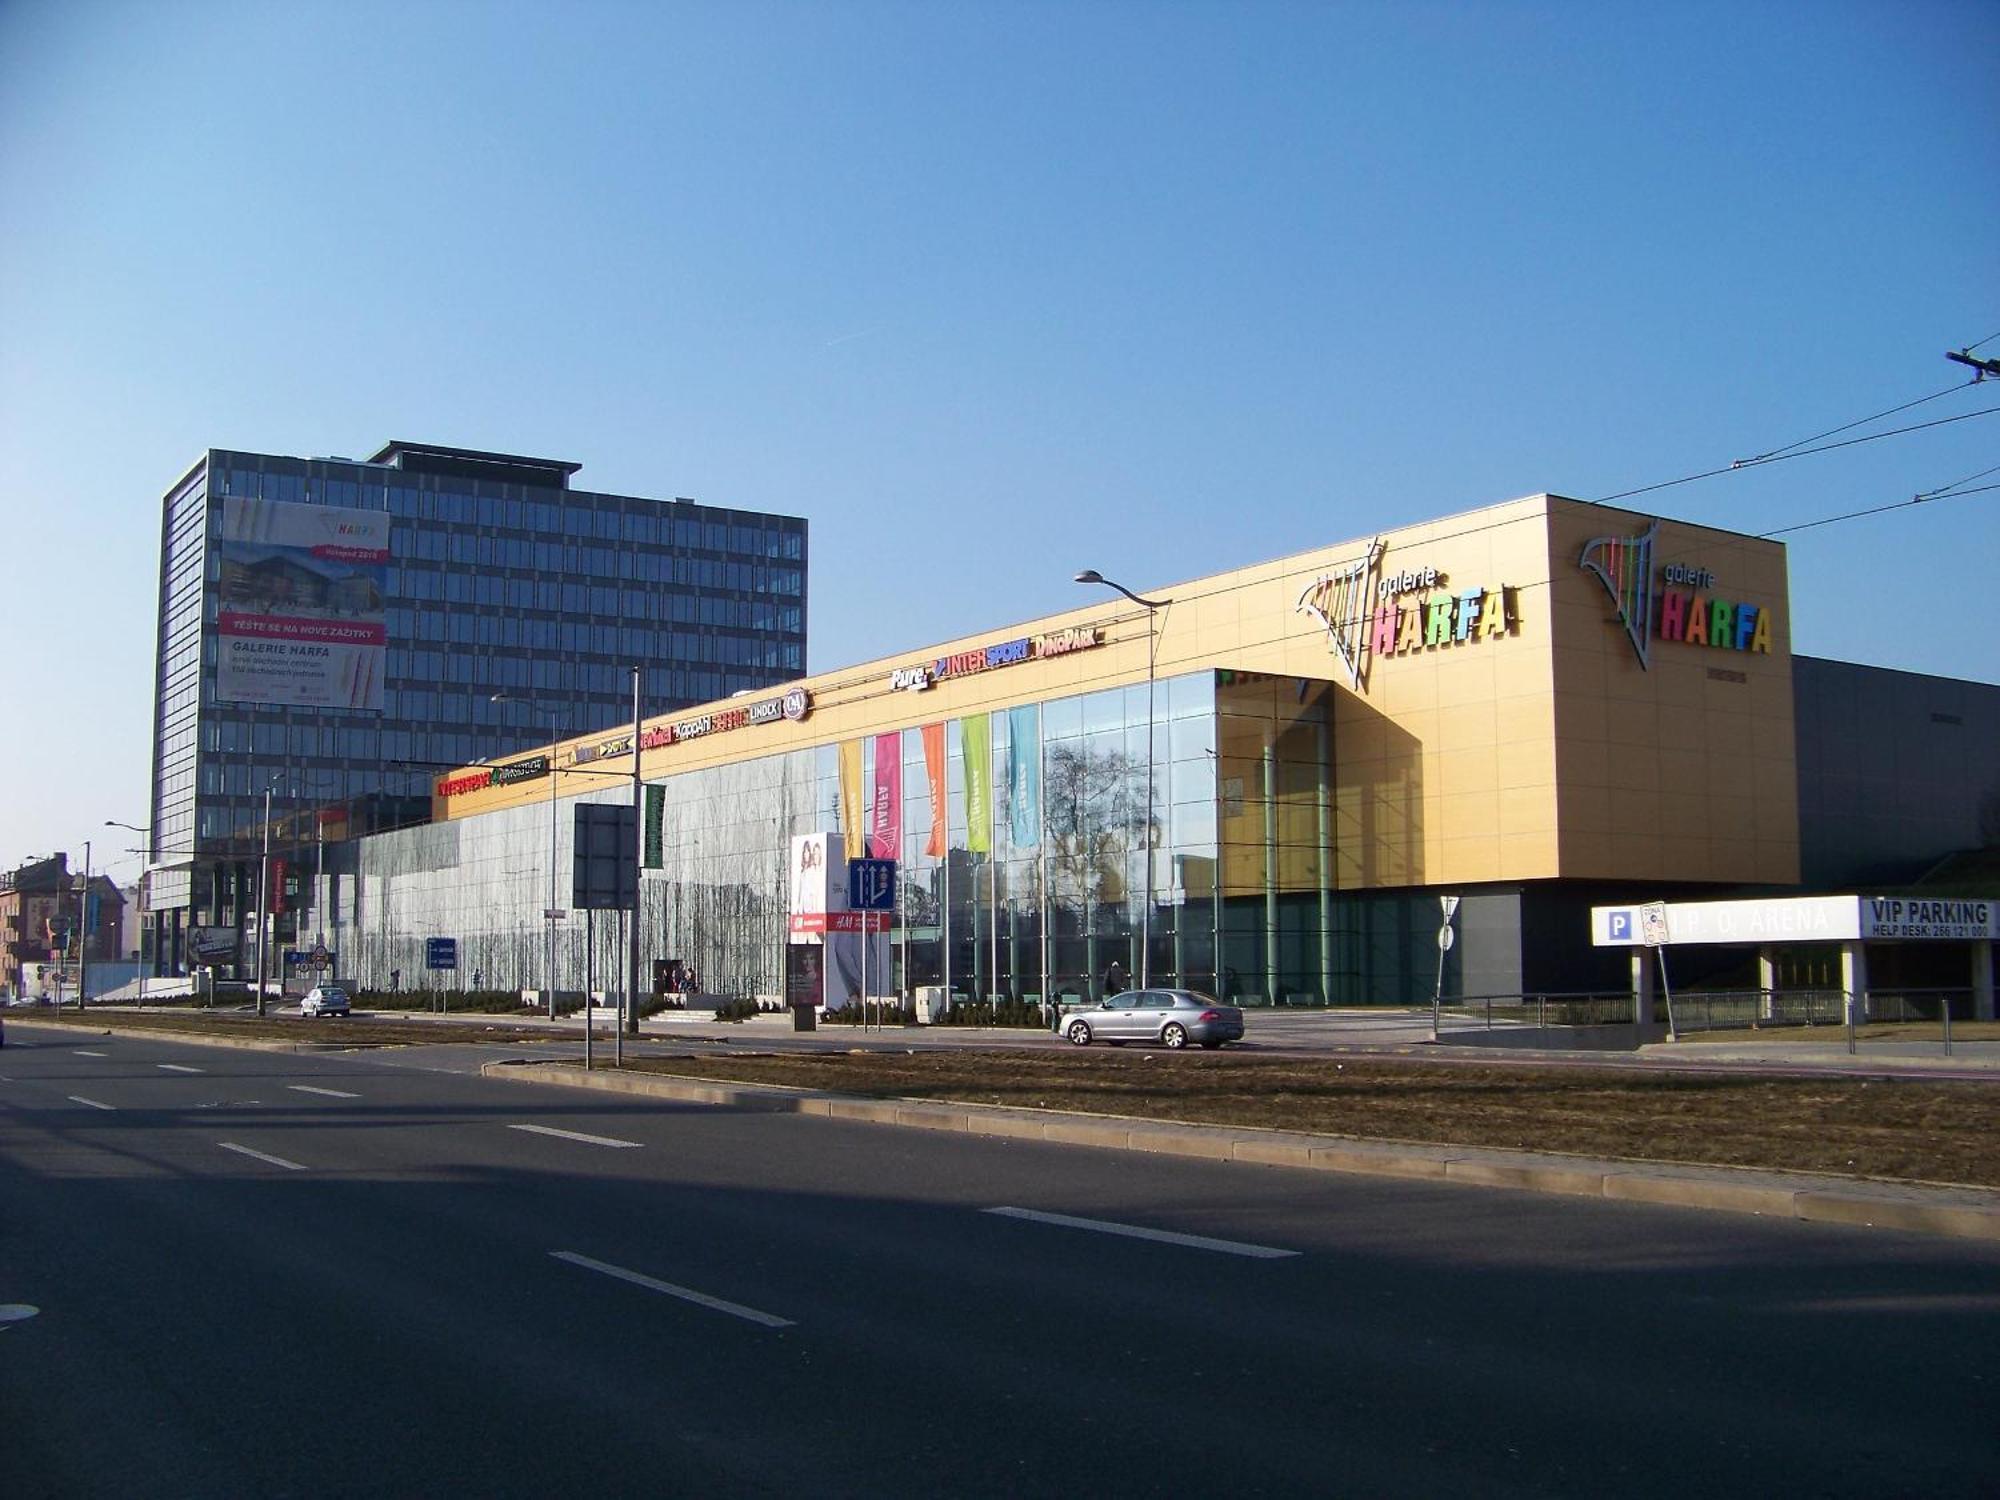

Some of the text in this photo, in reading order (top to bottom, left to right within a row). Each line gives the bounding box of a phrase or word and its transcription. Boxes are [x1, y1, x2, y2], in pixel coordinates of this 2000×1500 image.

[1378, 565, 1437, 599] galerie
[1664, 563, 1717, 589] galerie
[1371, 584, 1506, 655] HARFA
[1661, 591, 1773, 656] HARFA
[232, 641, 330, 657] GALERIE HARFA
[877, 785, 889, 828] HARFA
[1613, 916, 1626, 936] P
[1751, 902, 1830, 933] ARENA
[1871, 900, 1987, 924] VIP PARKING
[1872, 924, 1899, 937] HELP
